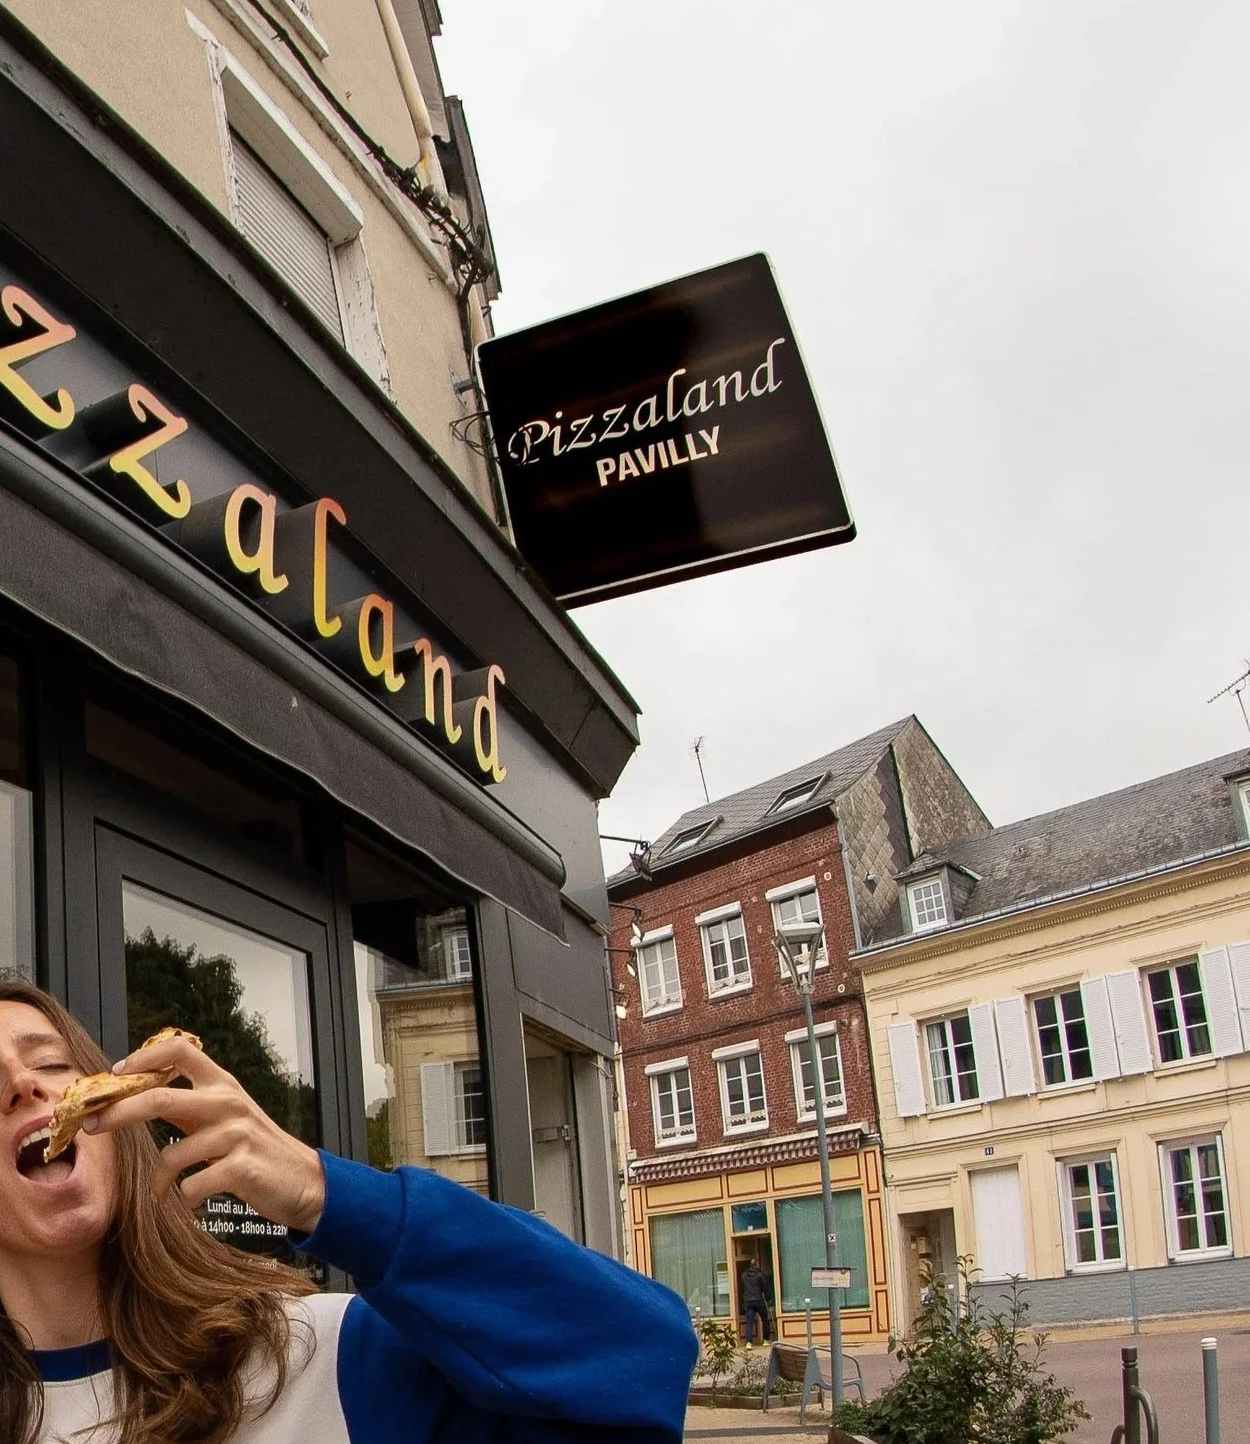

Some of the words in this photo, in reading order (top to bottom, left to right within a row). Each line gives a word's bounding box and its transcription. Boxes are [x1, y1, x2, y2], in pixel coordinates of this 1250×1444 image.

[507, 338, 785, 466] Pizzaland
[595, 425, 721, 487] PAVILLY
[206, 1199, 231, 1214] Lundi
[232, 1204, 244, 1215] au
[208, 1218, 234, 1234] 14h00
[241, 1220, 265, 1235] 18h00
[266, 1222, 272, 1235] à
